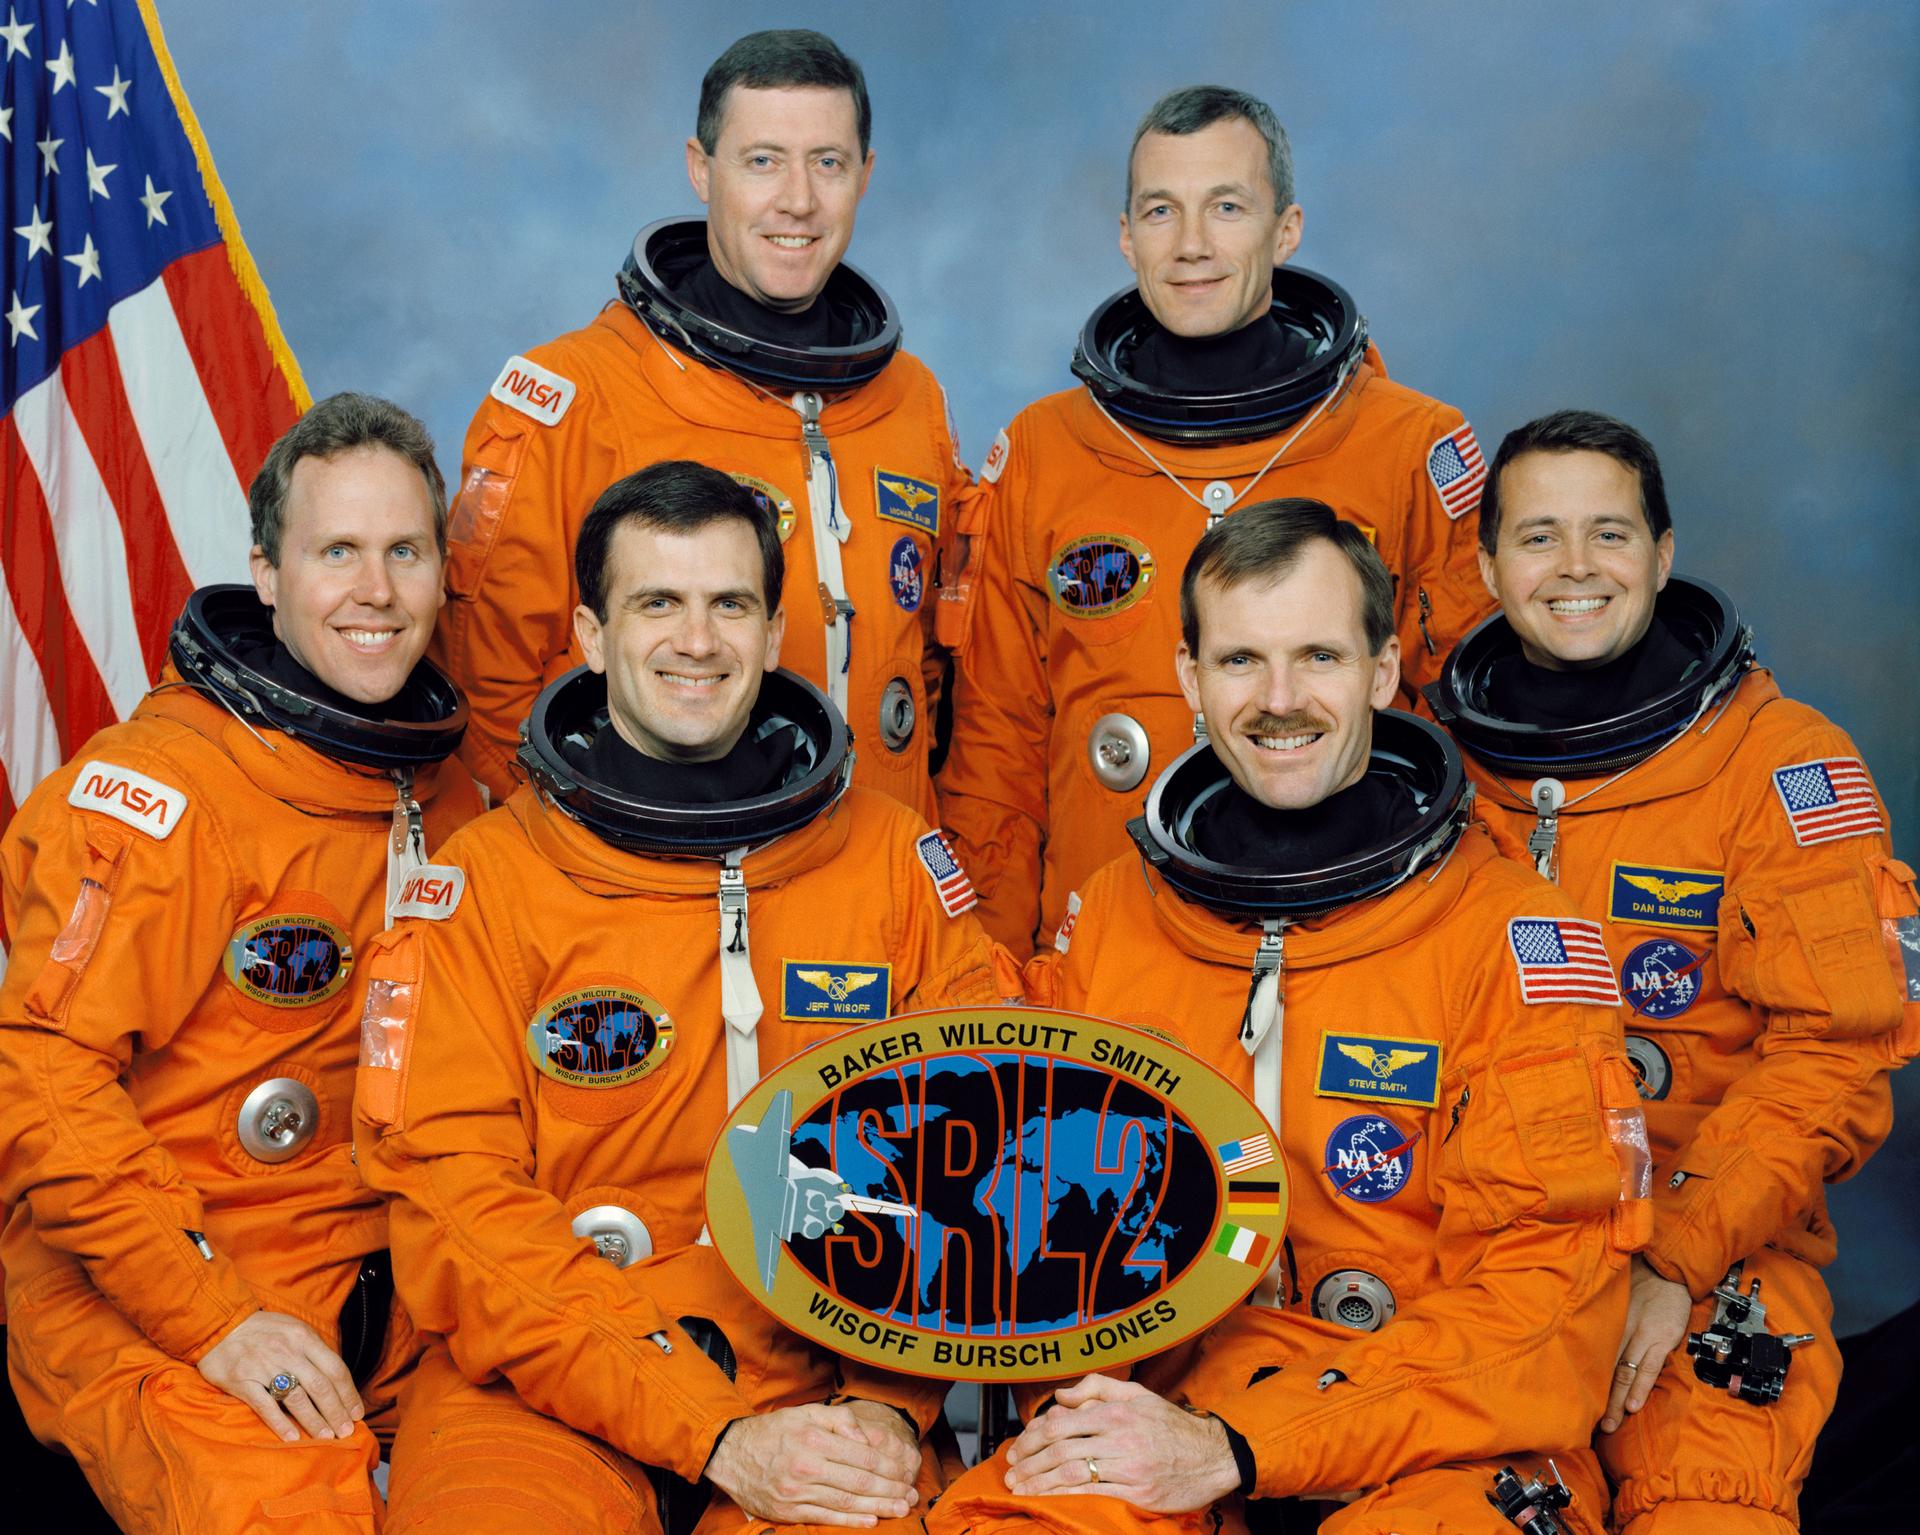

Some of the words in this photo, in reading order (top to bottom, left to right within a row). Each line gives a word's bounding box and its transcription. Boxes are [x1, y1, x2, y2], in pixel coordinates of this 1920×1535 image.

[501, 369, 562, 413] NASA
[1110, 536, 1130, 548] SMITH
[82, 774, 168, 825] NASA
[398, 876, 454, 907] NASA
[1632, 902, 1655, 914] DAN
[1658, 905, 1703, 919] BURSCH
[254, 918, 281, 933] BAKER
[283, 916, 315, 927] WILCUTT
[317, 921, 336, 937] SMITH
[1631, 970, 1695, 991] NASA
[245, 982, 271, 1001] WISOFF
[272, 996, 304, 1005] BURSCH
[307, 987, 331, 1003] JONES
[551, 995, 578, 1013] BAKER
[581, 989, 617, 1000] WILCUTT
[619, 991, 645, 1006] SMITH
[806, 1001, 829, 1013] JEFF
[833, 1002, 871, 1014] WISOFF
[818, 1031, 923, 1090] BAKER
[939, 1022, 1077, 1052] WILCUTT
[1090, 1038, 1181, 1096] SMITH
[554, 1066, 585, 1083] WISOFF
[588, 1074, 622, 1085] BURSCH
[625, 1060, 650, 1079] JONES
[1348, 1078, 1377, 1090] STEVE
[1380, 1081, 1408, 1094] SMITH
[1336, 1148, 1404, 1175] NASA
[826, 1050, 1173, 1337] SRL2
[808, 1291, 918, 1356] WISOFF
[933, 1340, 1061, 1368] BURSCH
[1079, 1299, 1177, 1358] JONES
